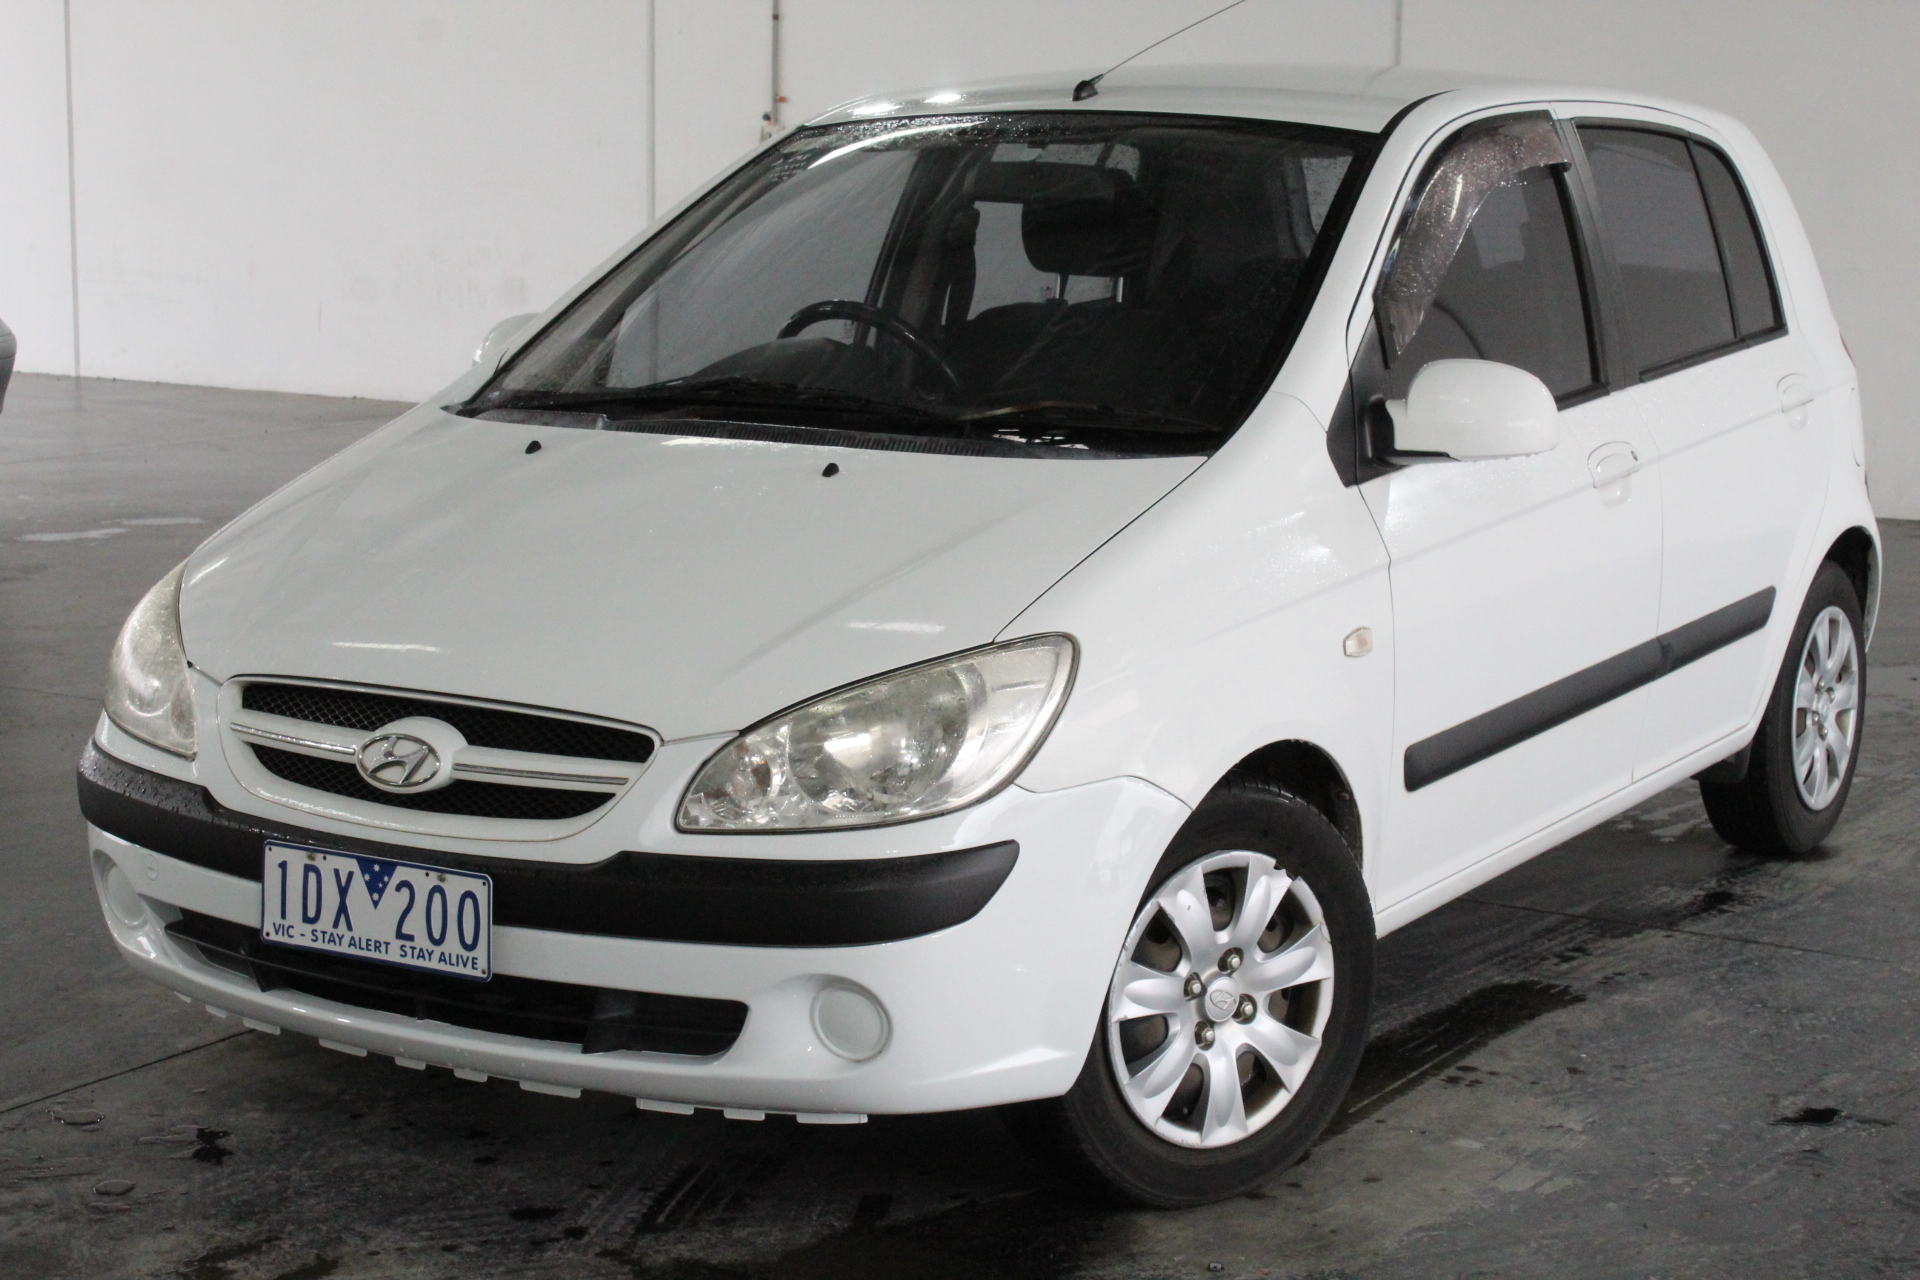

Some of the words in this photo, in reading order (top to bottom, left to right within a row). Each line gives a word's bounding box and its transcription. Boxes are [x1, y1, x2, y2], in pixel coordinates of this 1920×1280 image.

[278, 860, 354, 931] 1DX
[395, 880, 481, 951] 200
[273, 922, 294, 939] VIC
[311, 929, 344, 947] STAY
[348, 936, 391, 954] ALERT
[400, 944, 434, 962] STAY
[439, 952, 479, 970] ALIVE
